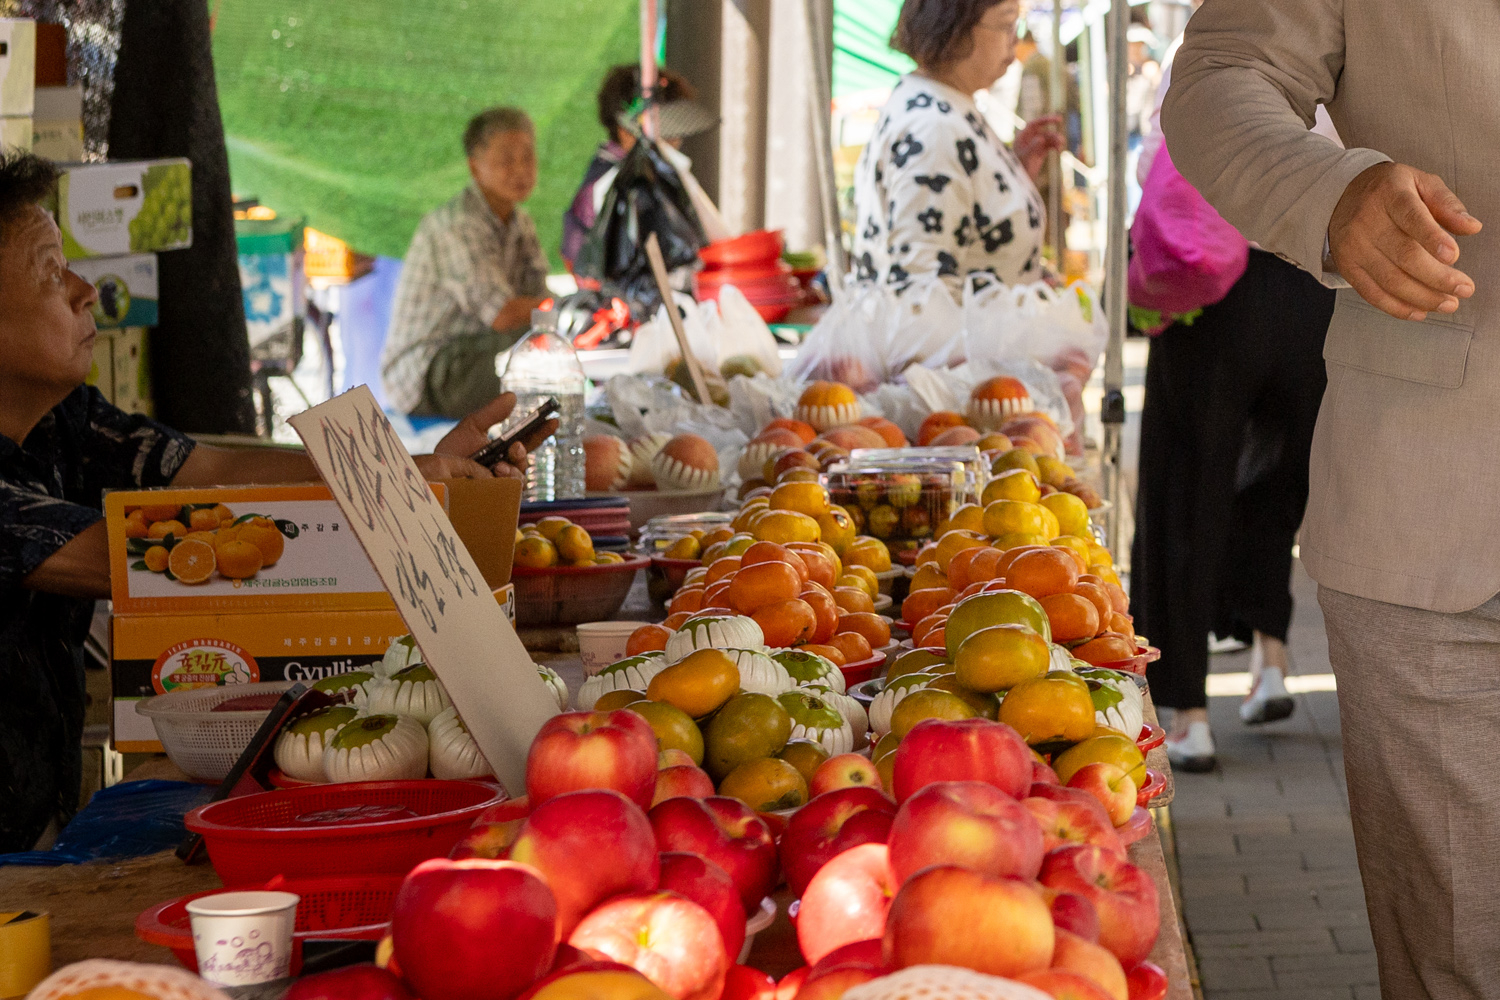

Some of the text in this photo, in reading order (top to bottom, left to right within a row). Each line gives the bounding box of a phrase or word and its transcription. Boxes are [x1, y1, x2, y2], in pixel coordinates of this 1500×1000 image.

[243, 577, 338, 588] 제주감귤농업협동조합
[508, 591, 514, 619] 2
[167, 639, 242, 656] JEJU MANDARIN
[284, 659, 361, 681] Gyulli
